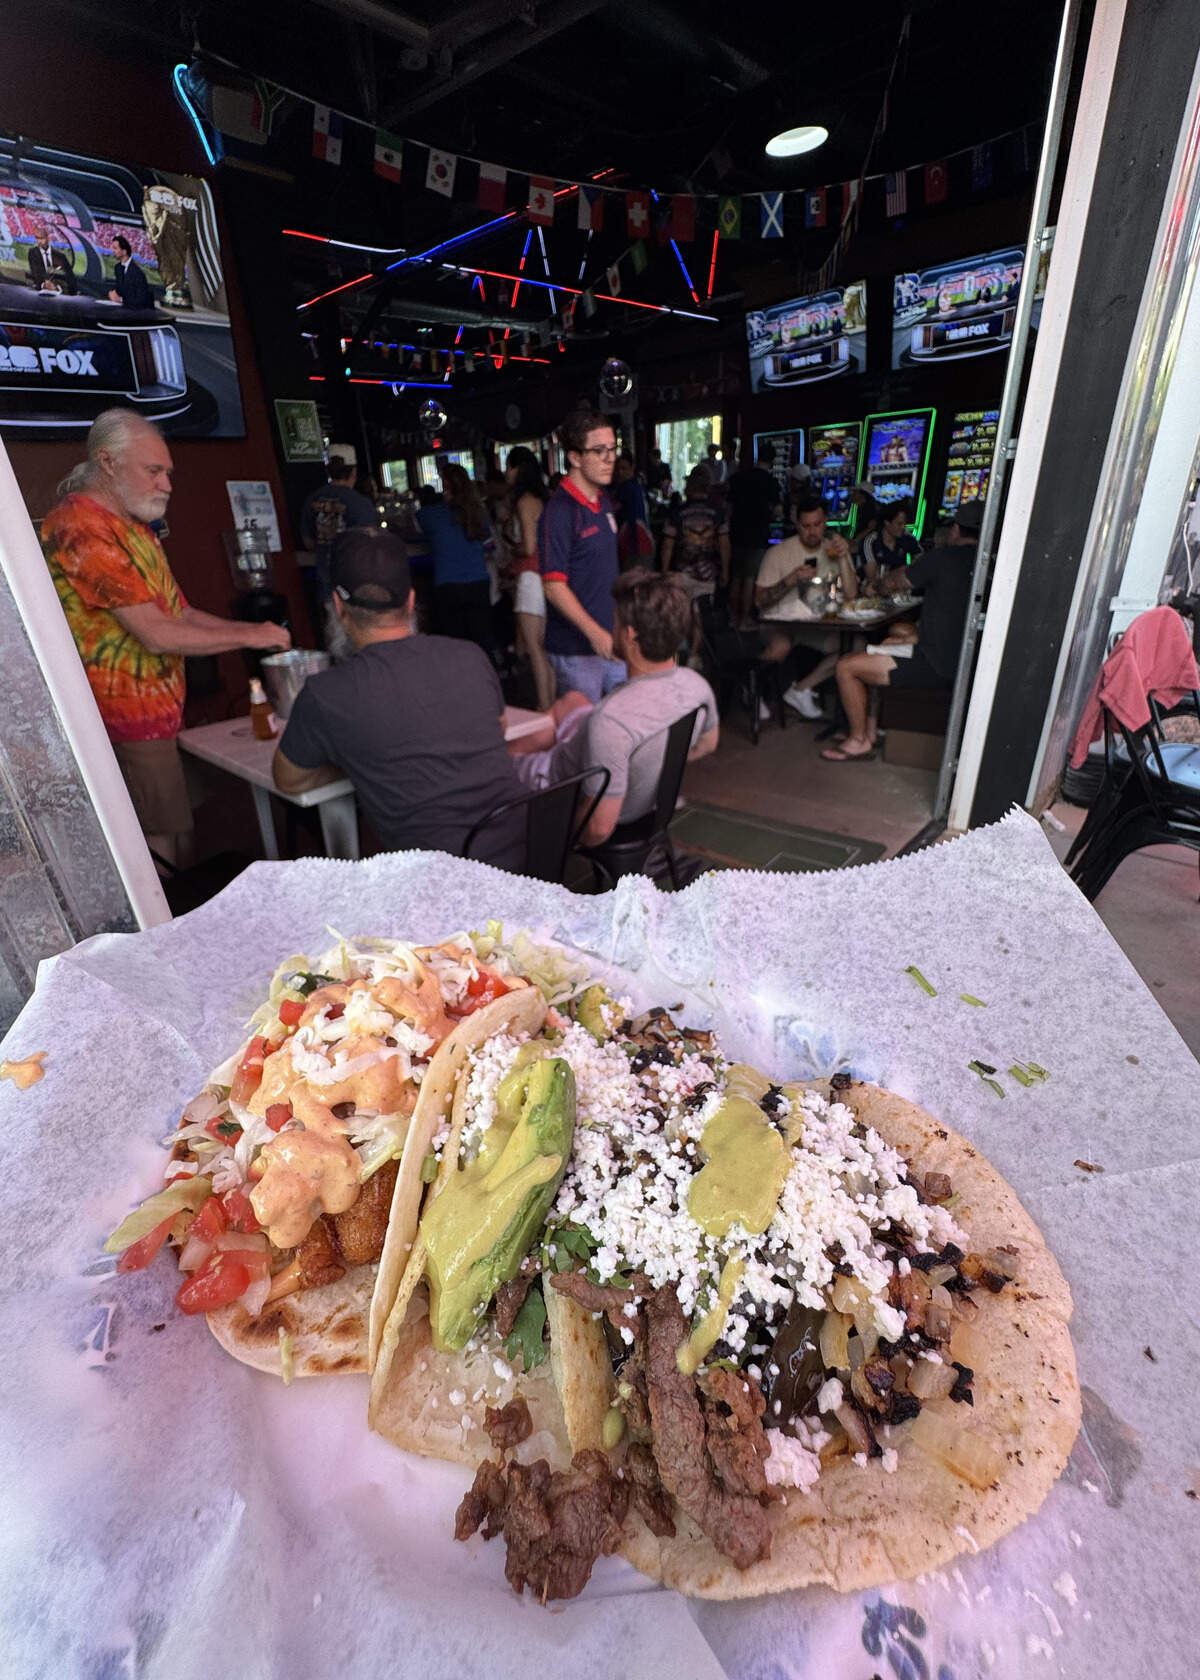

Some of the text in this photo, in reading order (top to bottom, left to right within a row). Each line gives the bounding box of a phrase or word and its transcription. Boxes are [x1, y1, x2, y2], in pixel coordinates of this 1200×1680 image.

[177, 195, 198, 211] FOX
[968, 322, 990, 337] FOX
[39, 347, 99, 376] FOX
